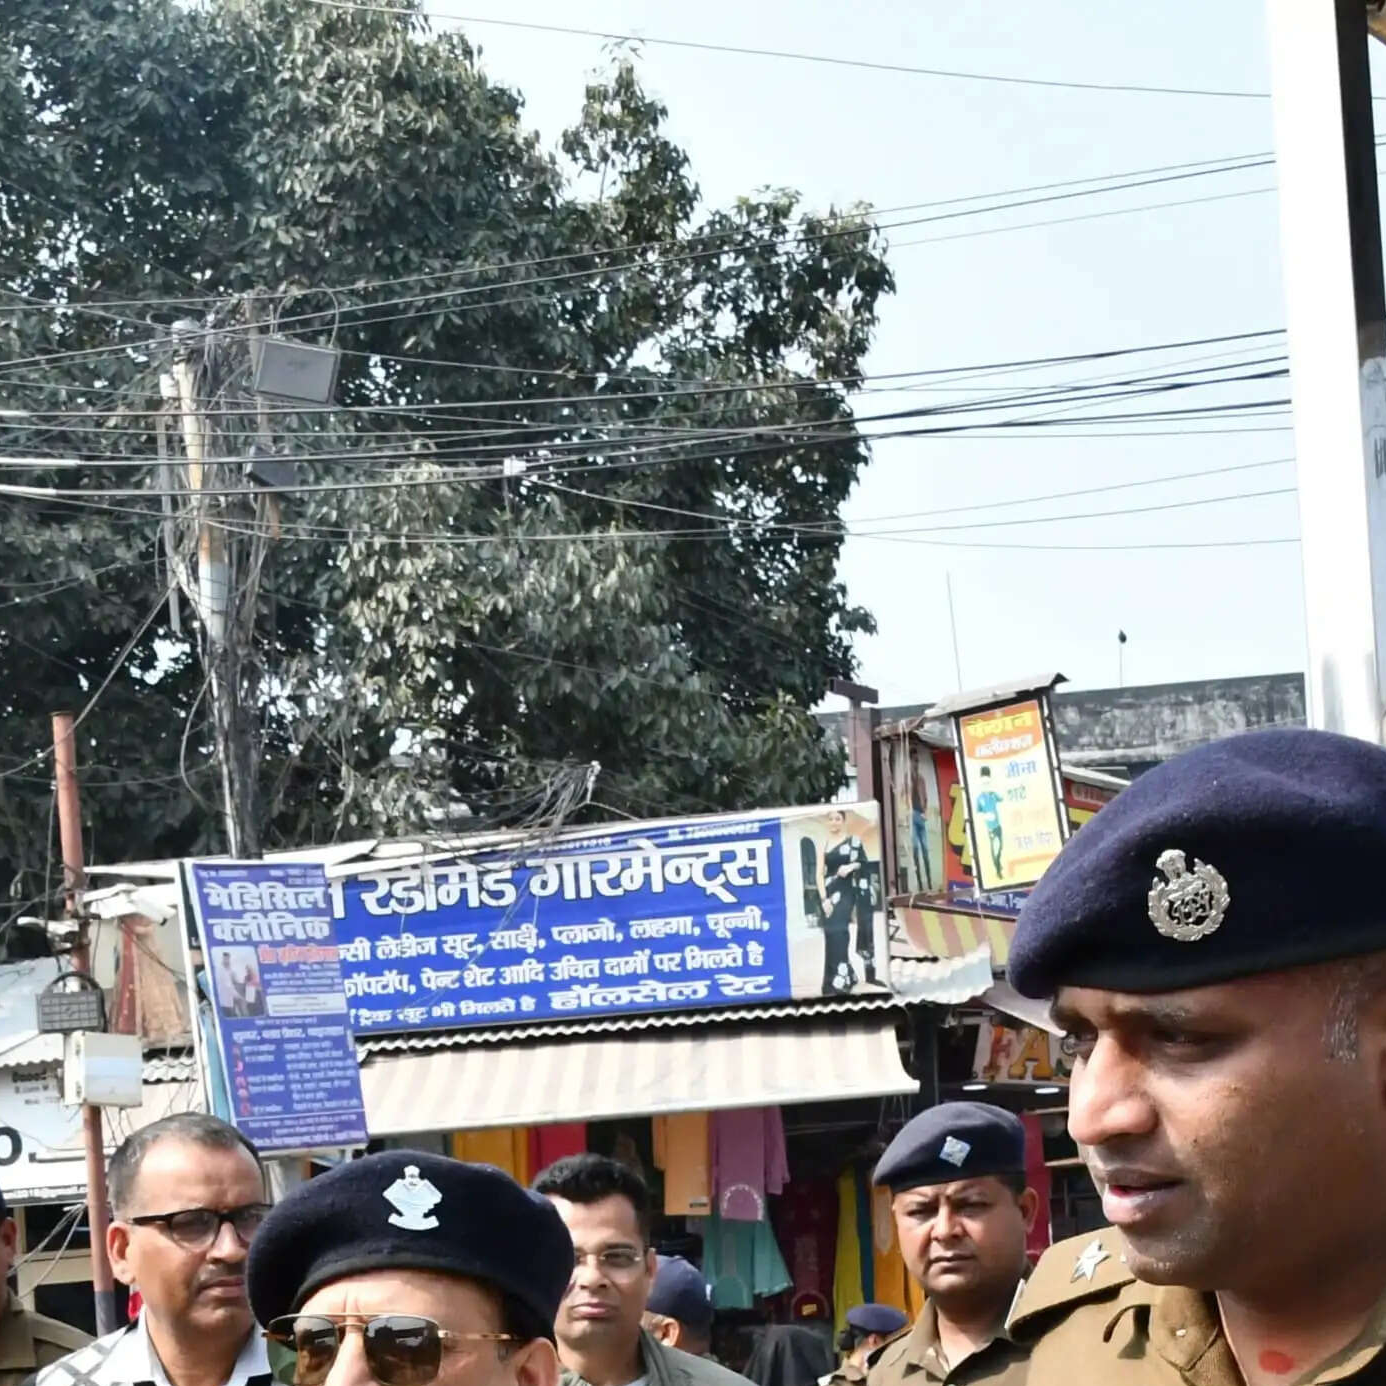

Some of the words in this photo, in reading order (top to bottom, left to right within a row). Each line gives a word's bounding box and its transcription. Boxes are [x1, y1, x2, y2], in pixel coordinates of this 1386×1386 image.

[376, 931, 437, 961] लेडीज
[500, 959, 545, 985] आदि
[550, 955, 600, 980] उचित
[653, 952, 683, 972] पर
[684, 943, 743, 970] मिलते
[547, 978, 713, 1011] हॉलसेल
[714, 973, 774, 997] रेट
